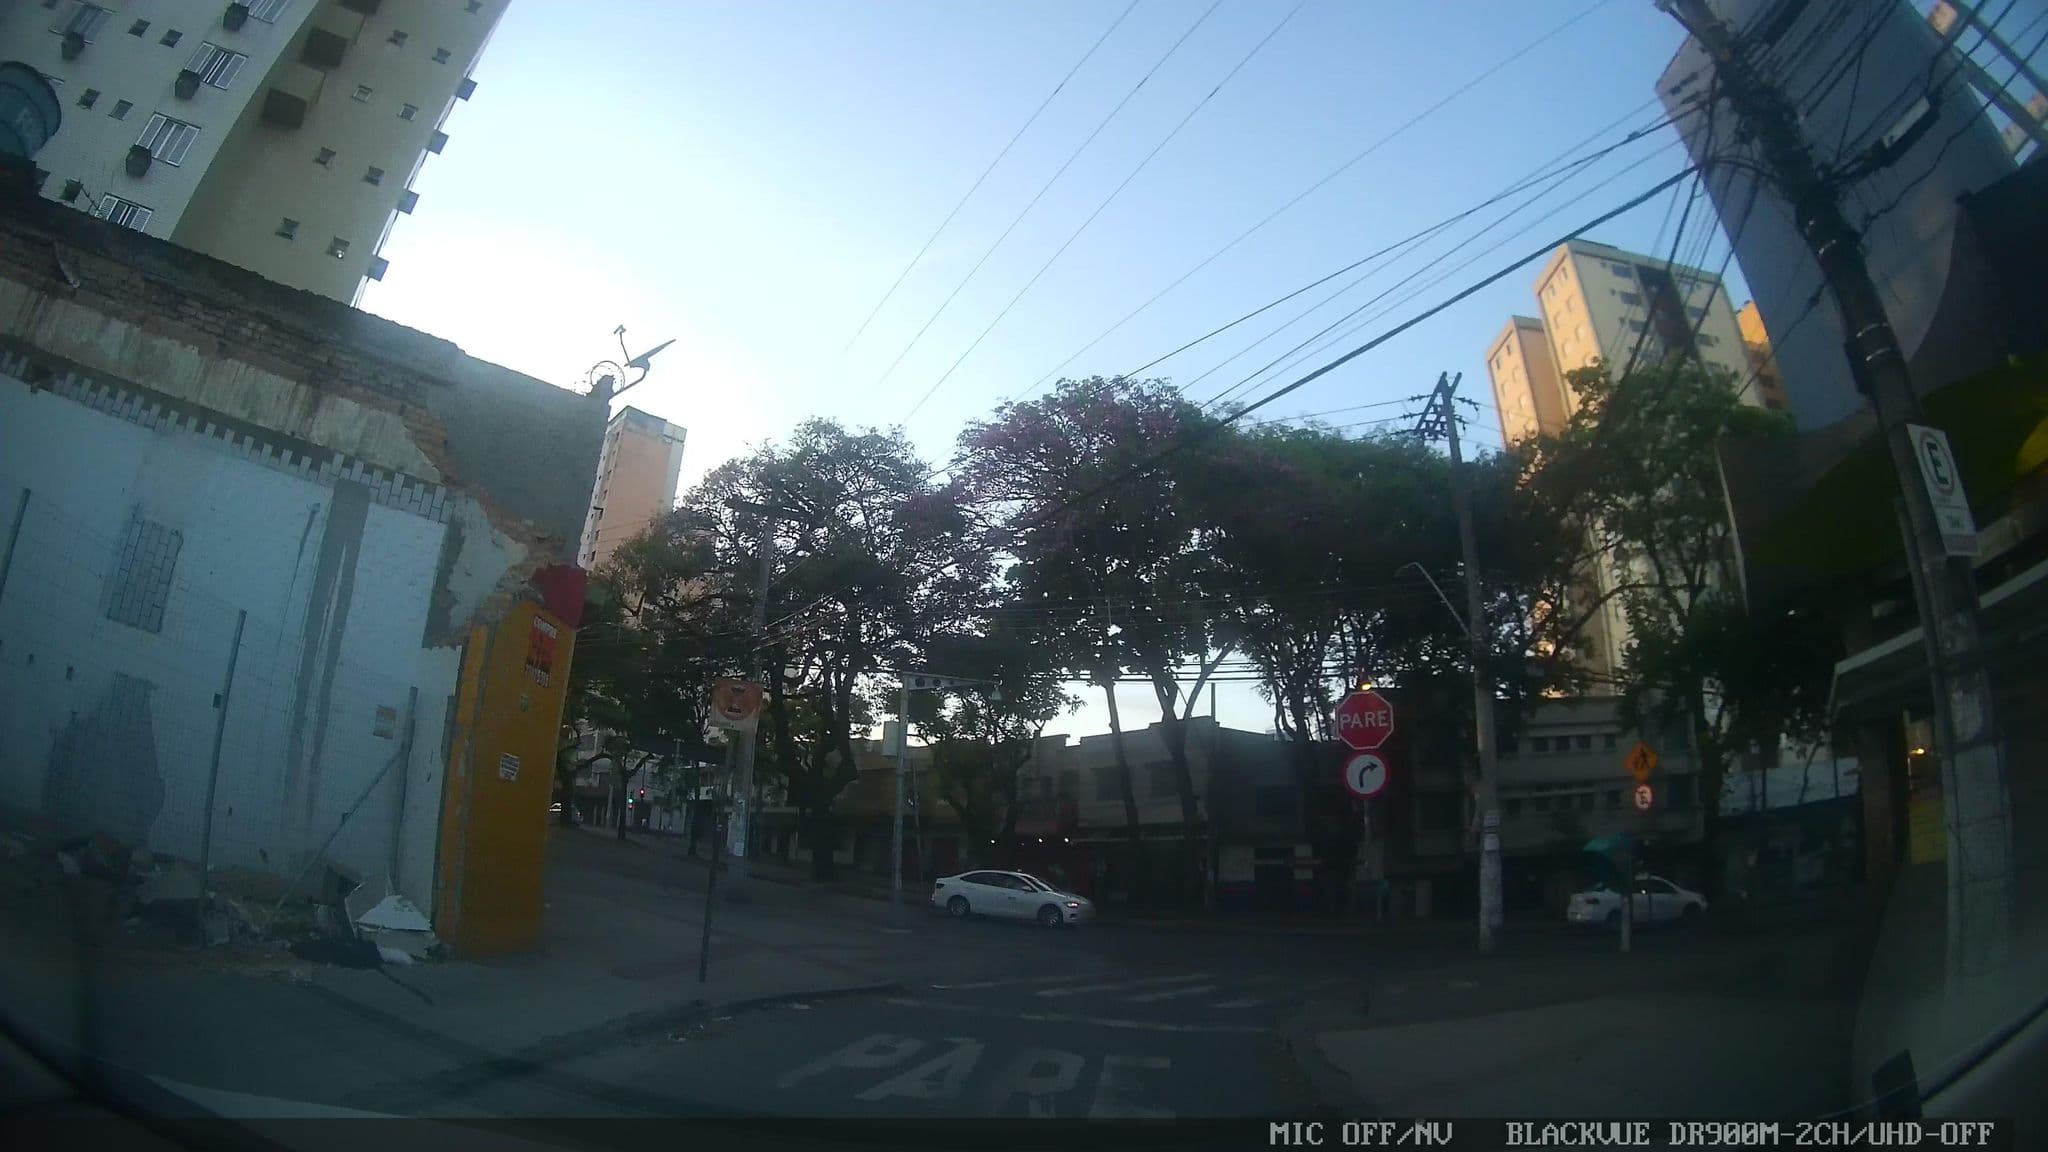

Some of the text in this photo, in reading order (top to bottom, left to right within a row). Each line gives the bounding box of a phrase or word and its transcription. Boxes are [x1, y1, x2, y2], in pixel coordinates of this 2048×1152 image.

[1927, 442, 1949, 485] E
[1340, 710, 1388, 731] PARE
[776, 1031, 1177, 1124] PARE
